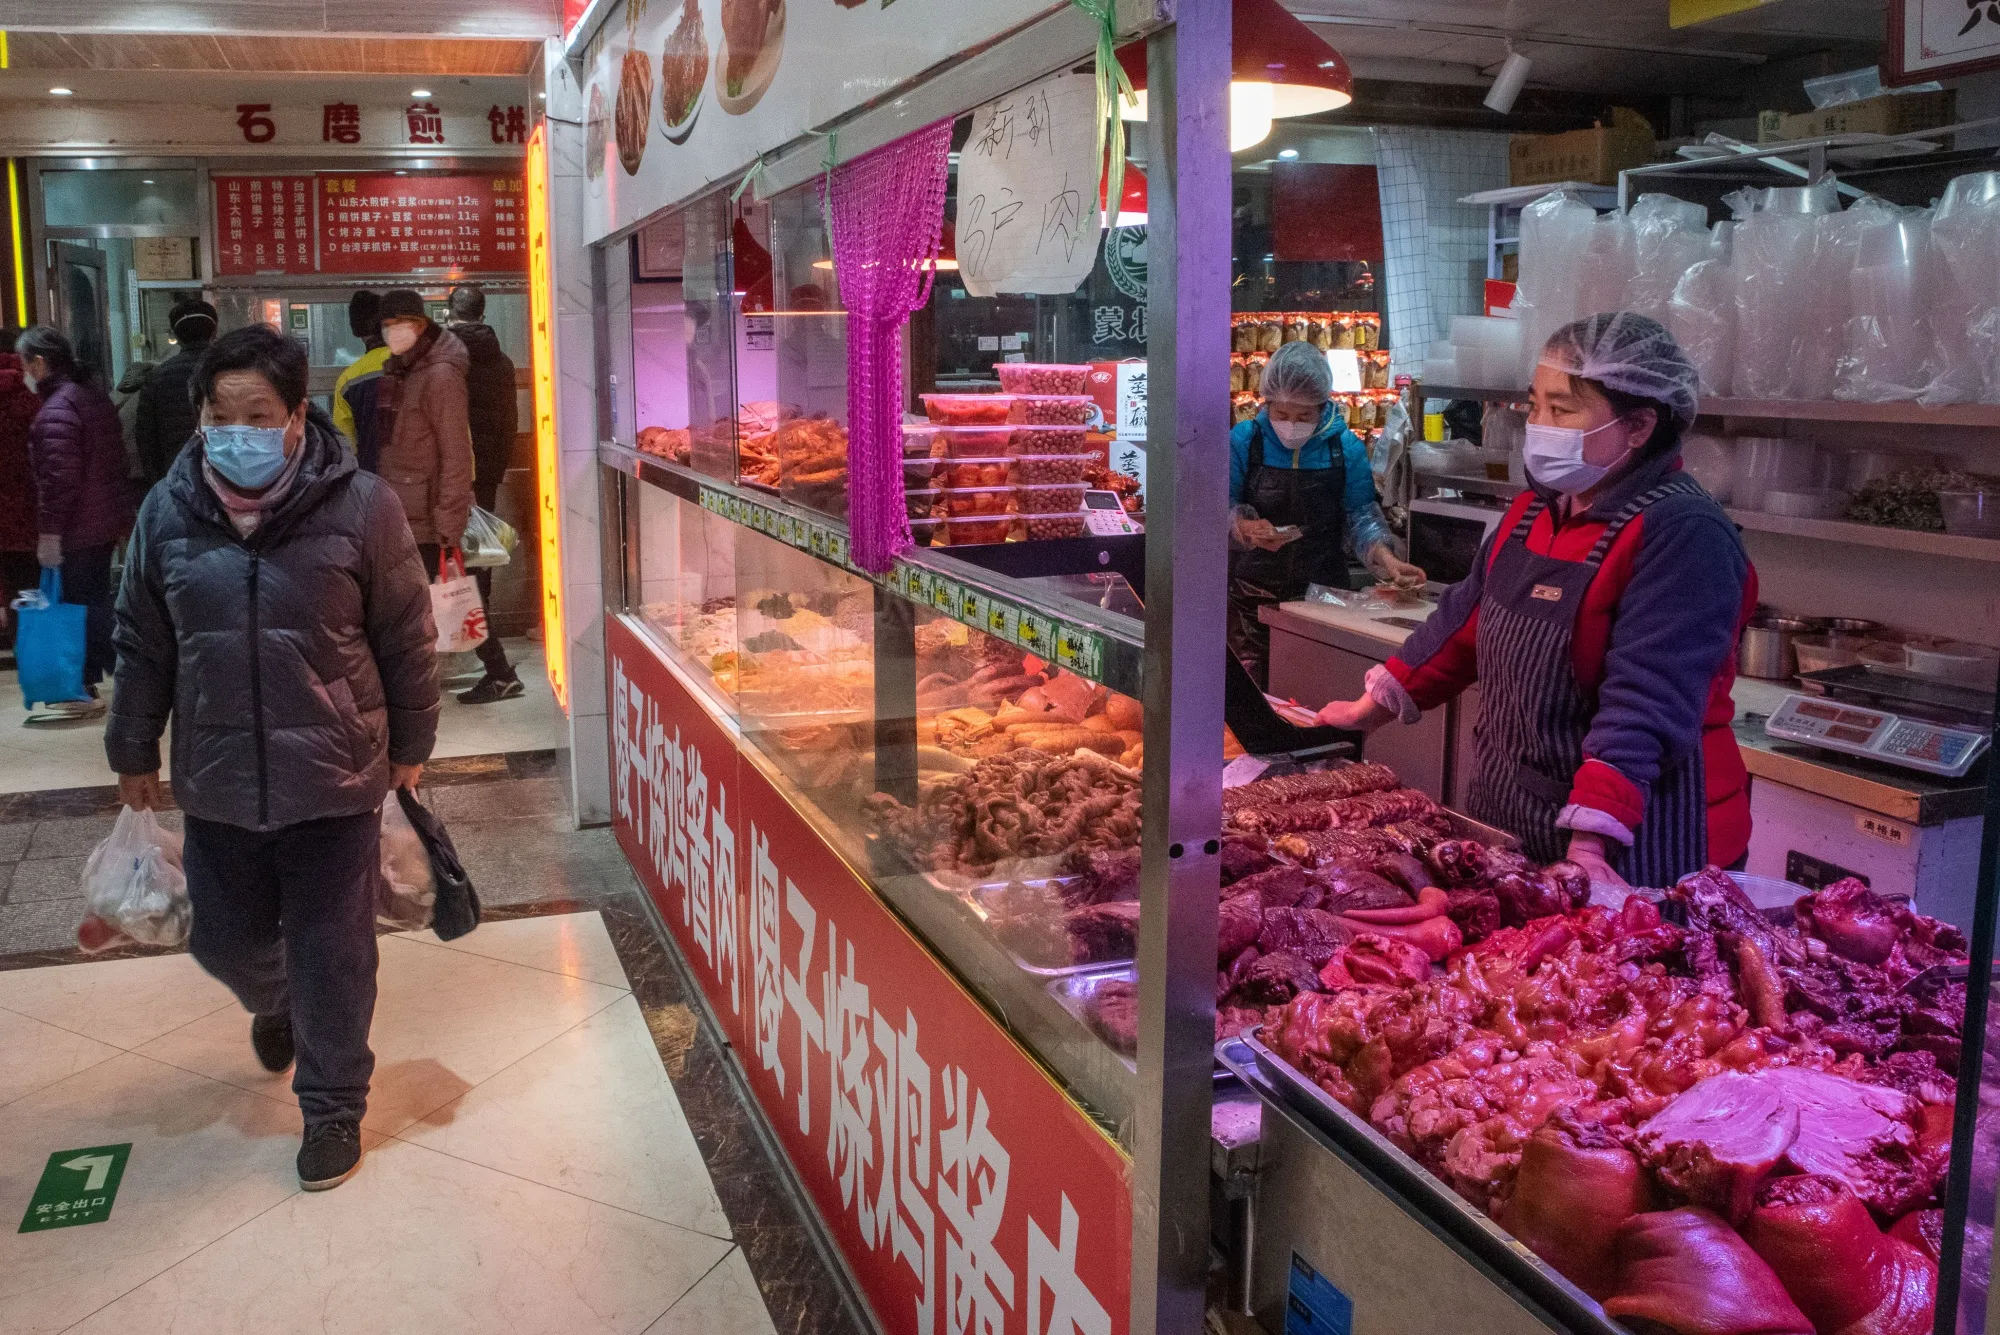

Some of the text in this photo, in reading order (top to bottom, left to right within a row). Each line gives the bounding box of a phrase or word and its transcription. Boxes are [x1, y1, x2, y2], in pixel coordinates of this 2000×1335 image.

[236, 102, 525, 144] 石磨煎饼
[326, 179, 357, 193] 套餐
[328, 197, 335, 207] A
[457, 195, 480, 207] 12元
[228, 181, 242, 240] 山东大煎饼
[328, 212, 335, 222] B
[457, 211, 480, 222] 11元
[328, 227, 336, 237] C
[458, 226, 481, 237] 11元
[329, 242, 337, 252] D
[459, 241, 481, 252] 11元
[612, 652, 740, 1016] 傻子烧鸡酱肉
[36, 1197, 106, 1215] 安全出口
[40, 1211, 94, 1223] EXIT
